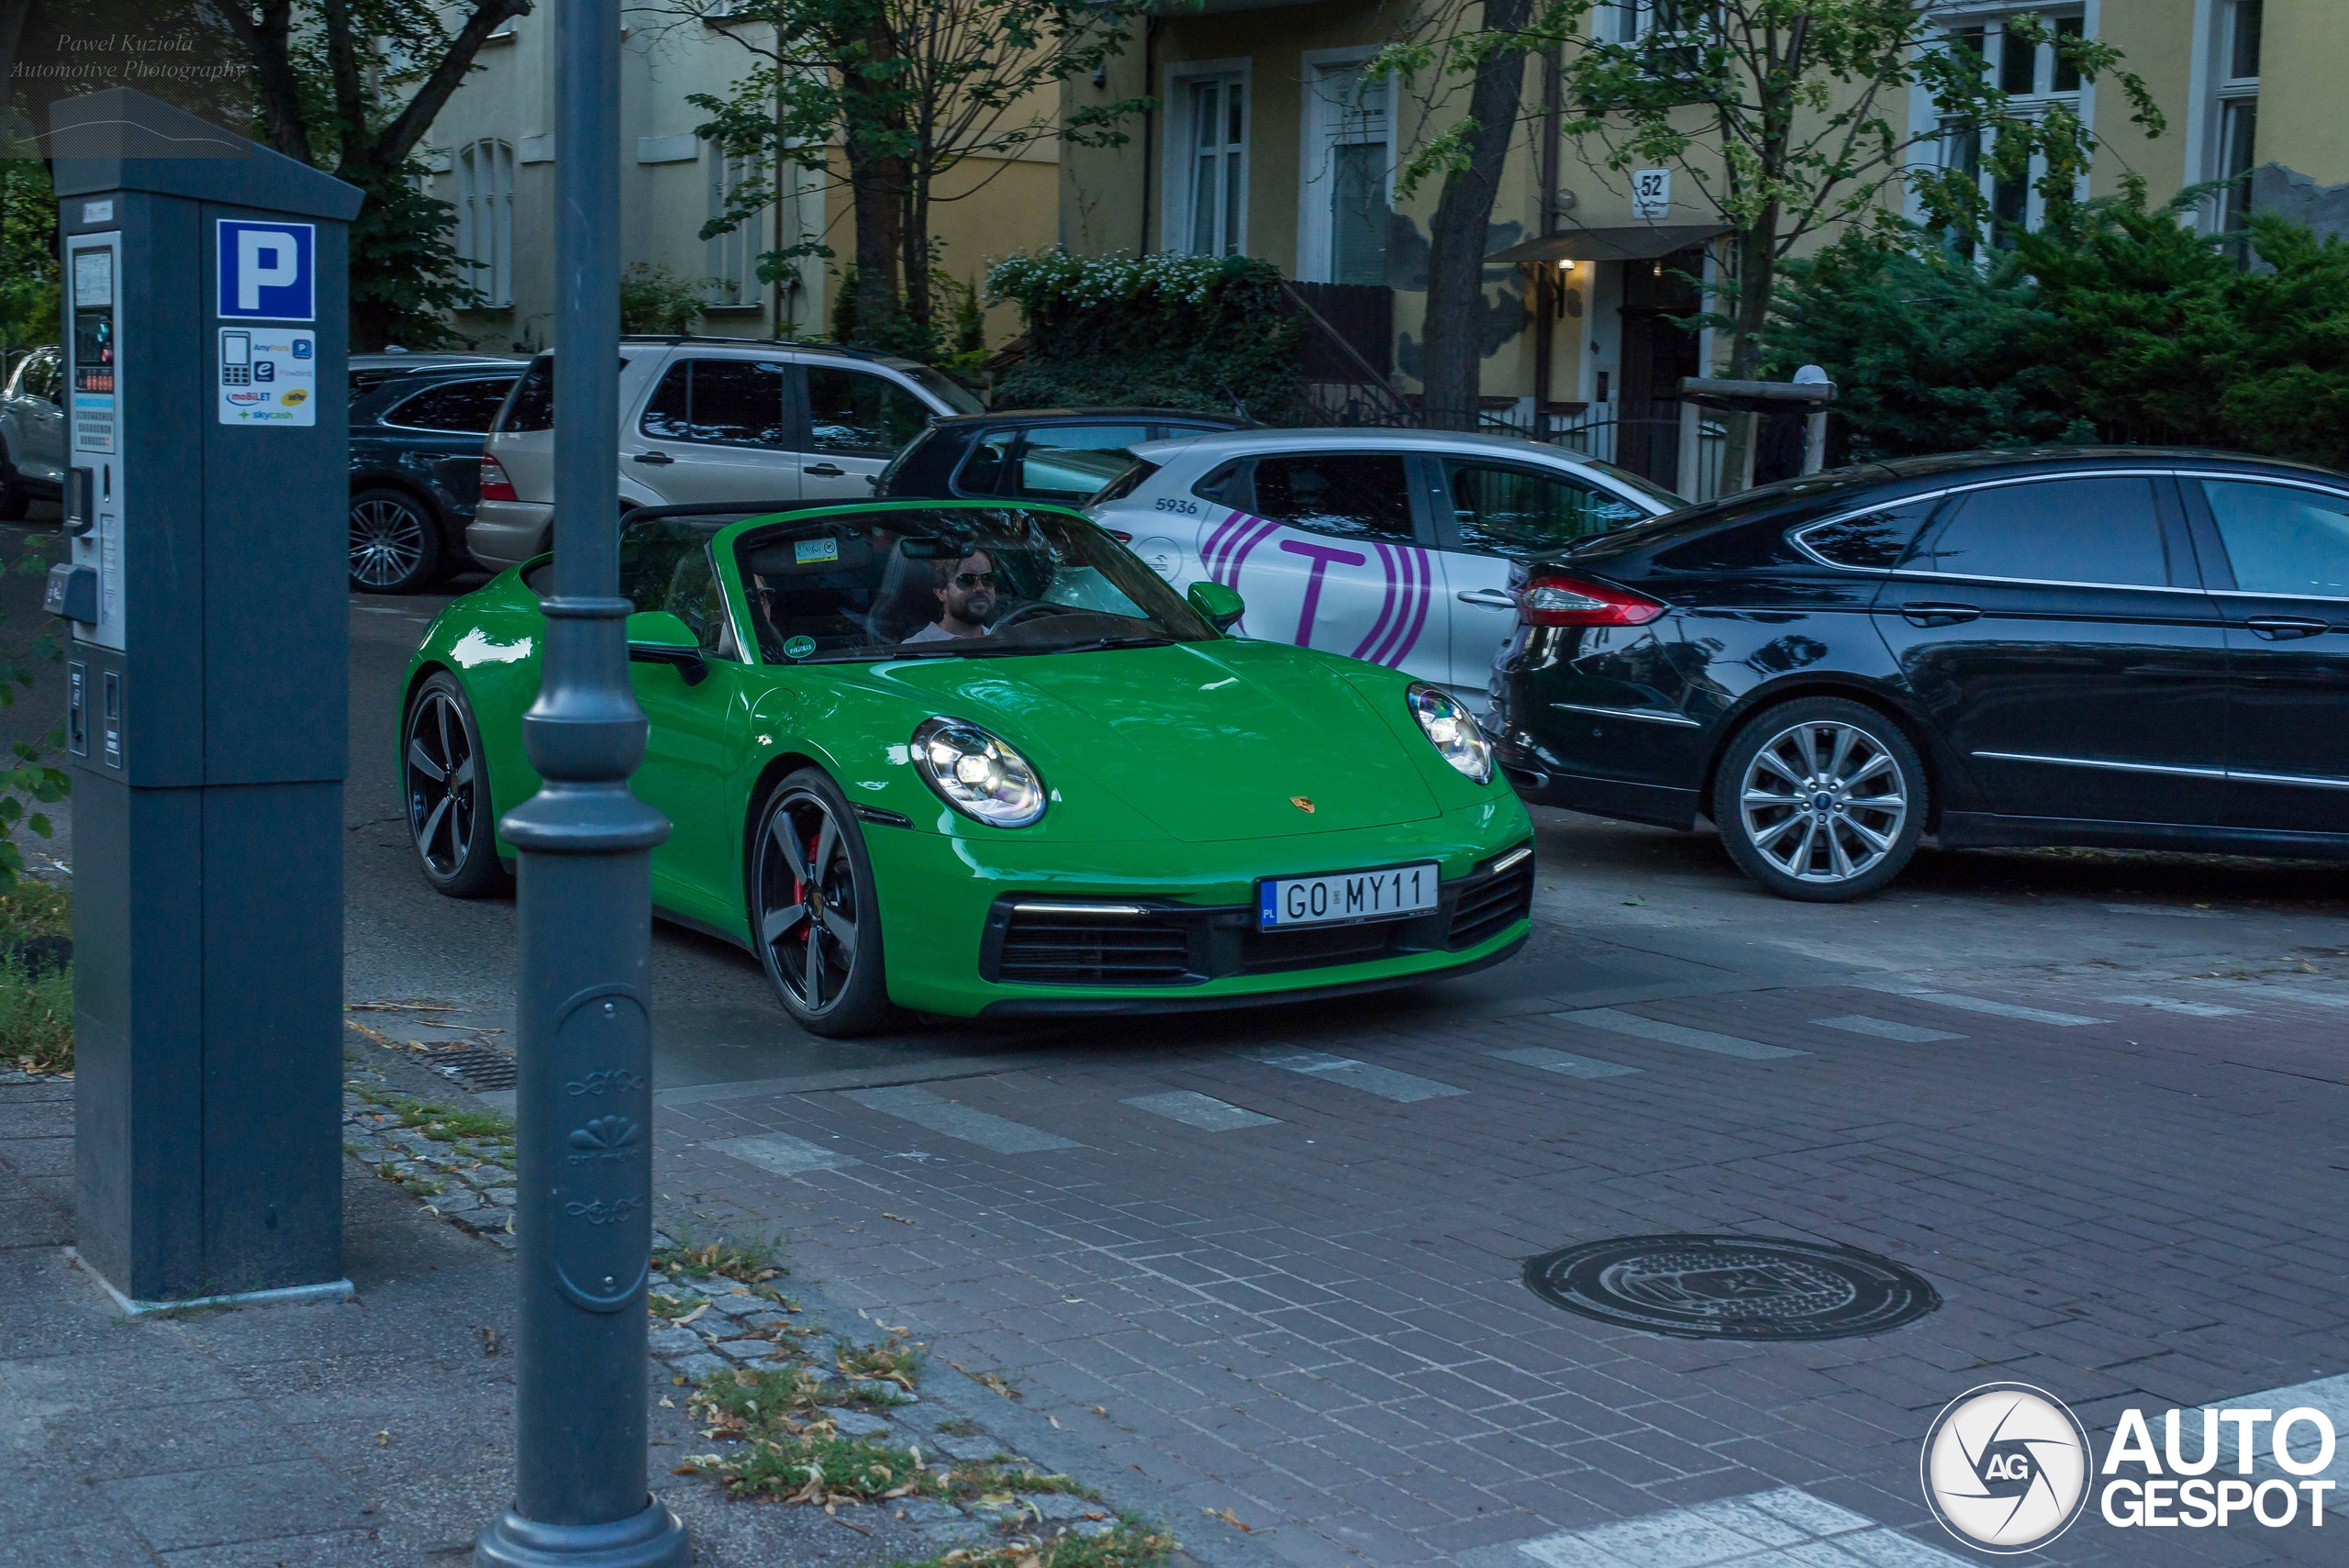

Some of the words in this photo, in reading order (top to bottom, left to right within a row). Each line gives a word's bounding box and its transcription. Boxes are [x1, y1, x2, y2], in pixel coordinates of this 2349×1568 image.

[1642, 175, 1662, 196] 52
[238, 229, 298, 310] P
[1155, 497, 1198, 515] 5936
[1346, 871, 1420, 914] MY11
[1264, 909, 1275, 918] PL
